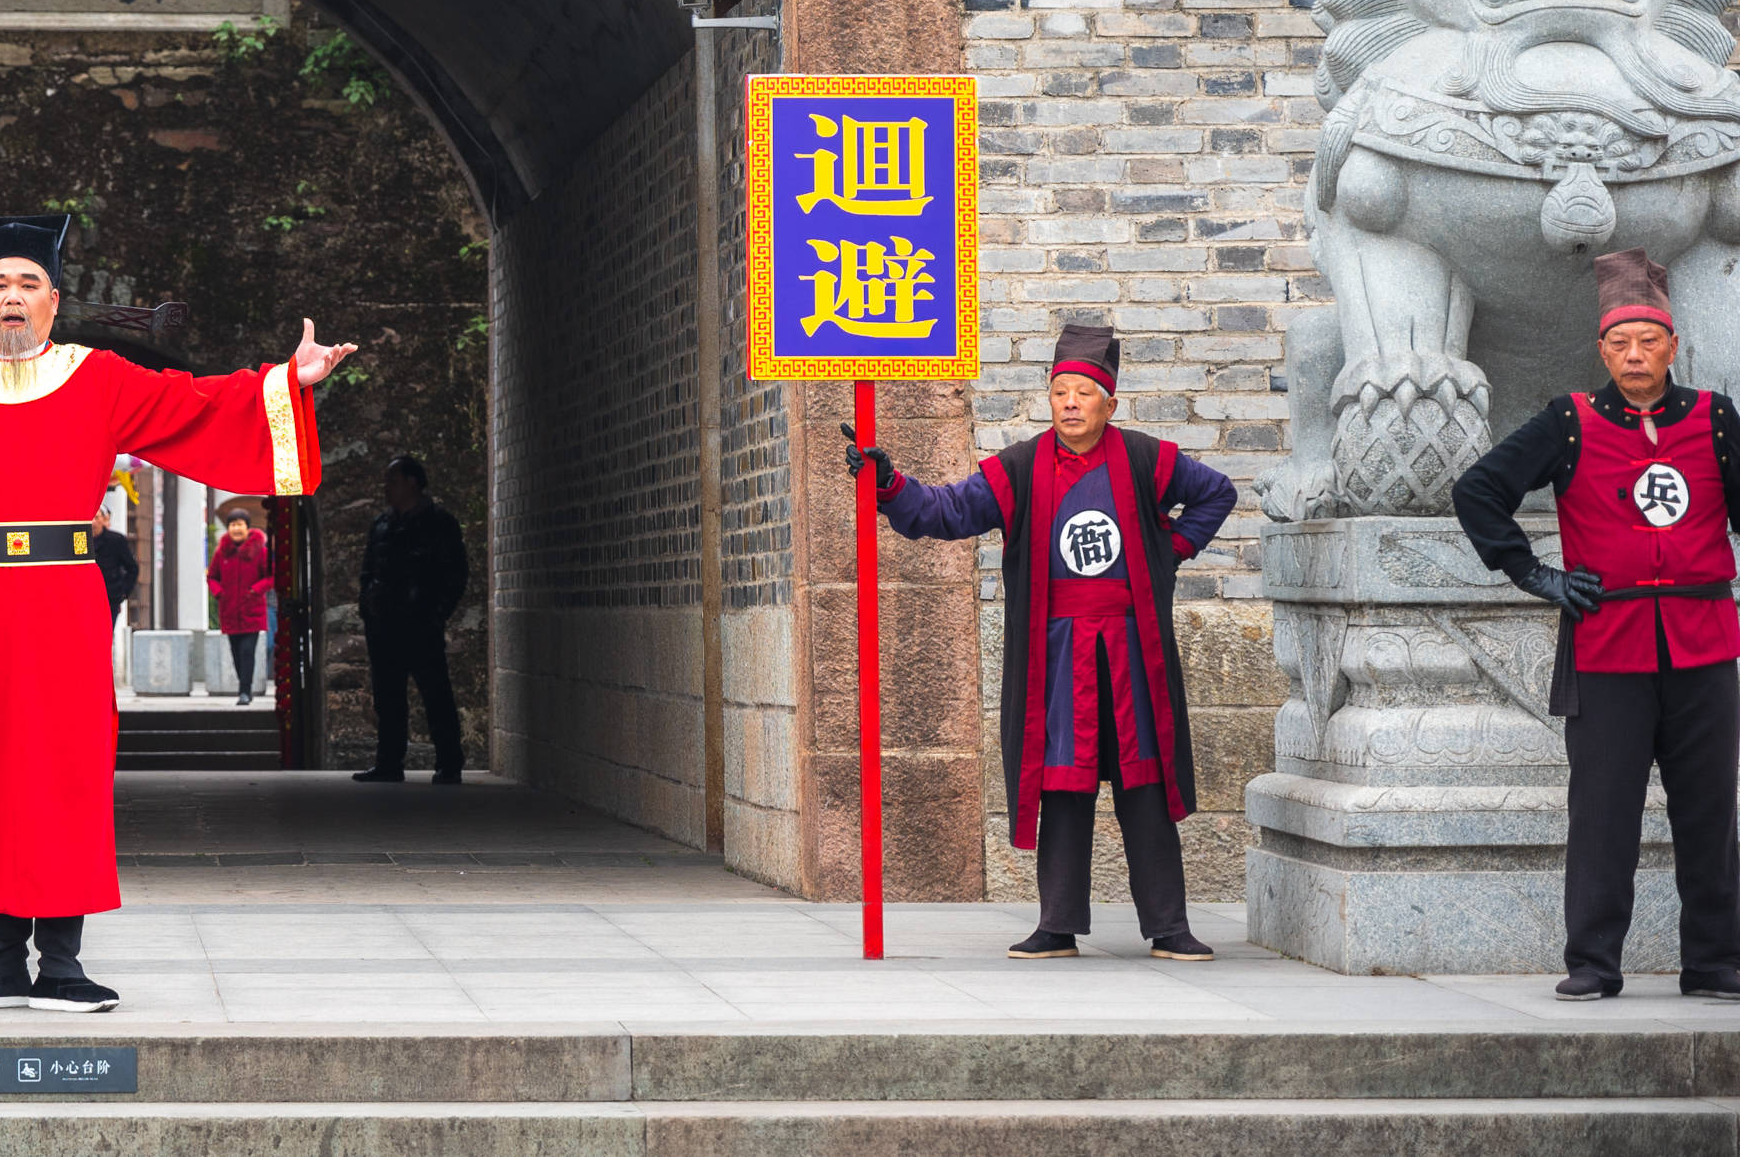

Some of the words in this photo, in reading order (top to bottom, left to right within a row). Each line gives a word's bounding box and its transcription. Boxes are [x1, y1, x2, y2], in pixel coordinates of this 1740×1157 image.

[793, 113, 939, 339] 迴避
[1639, 471, 1682, 518] 兵
[1066, 518, 1113, 573] 衙
[48, 1059, 112, 1076] 小心台阶
